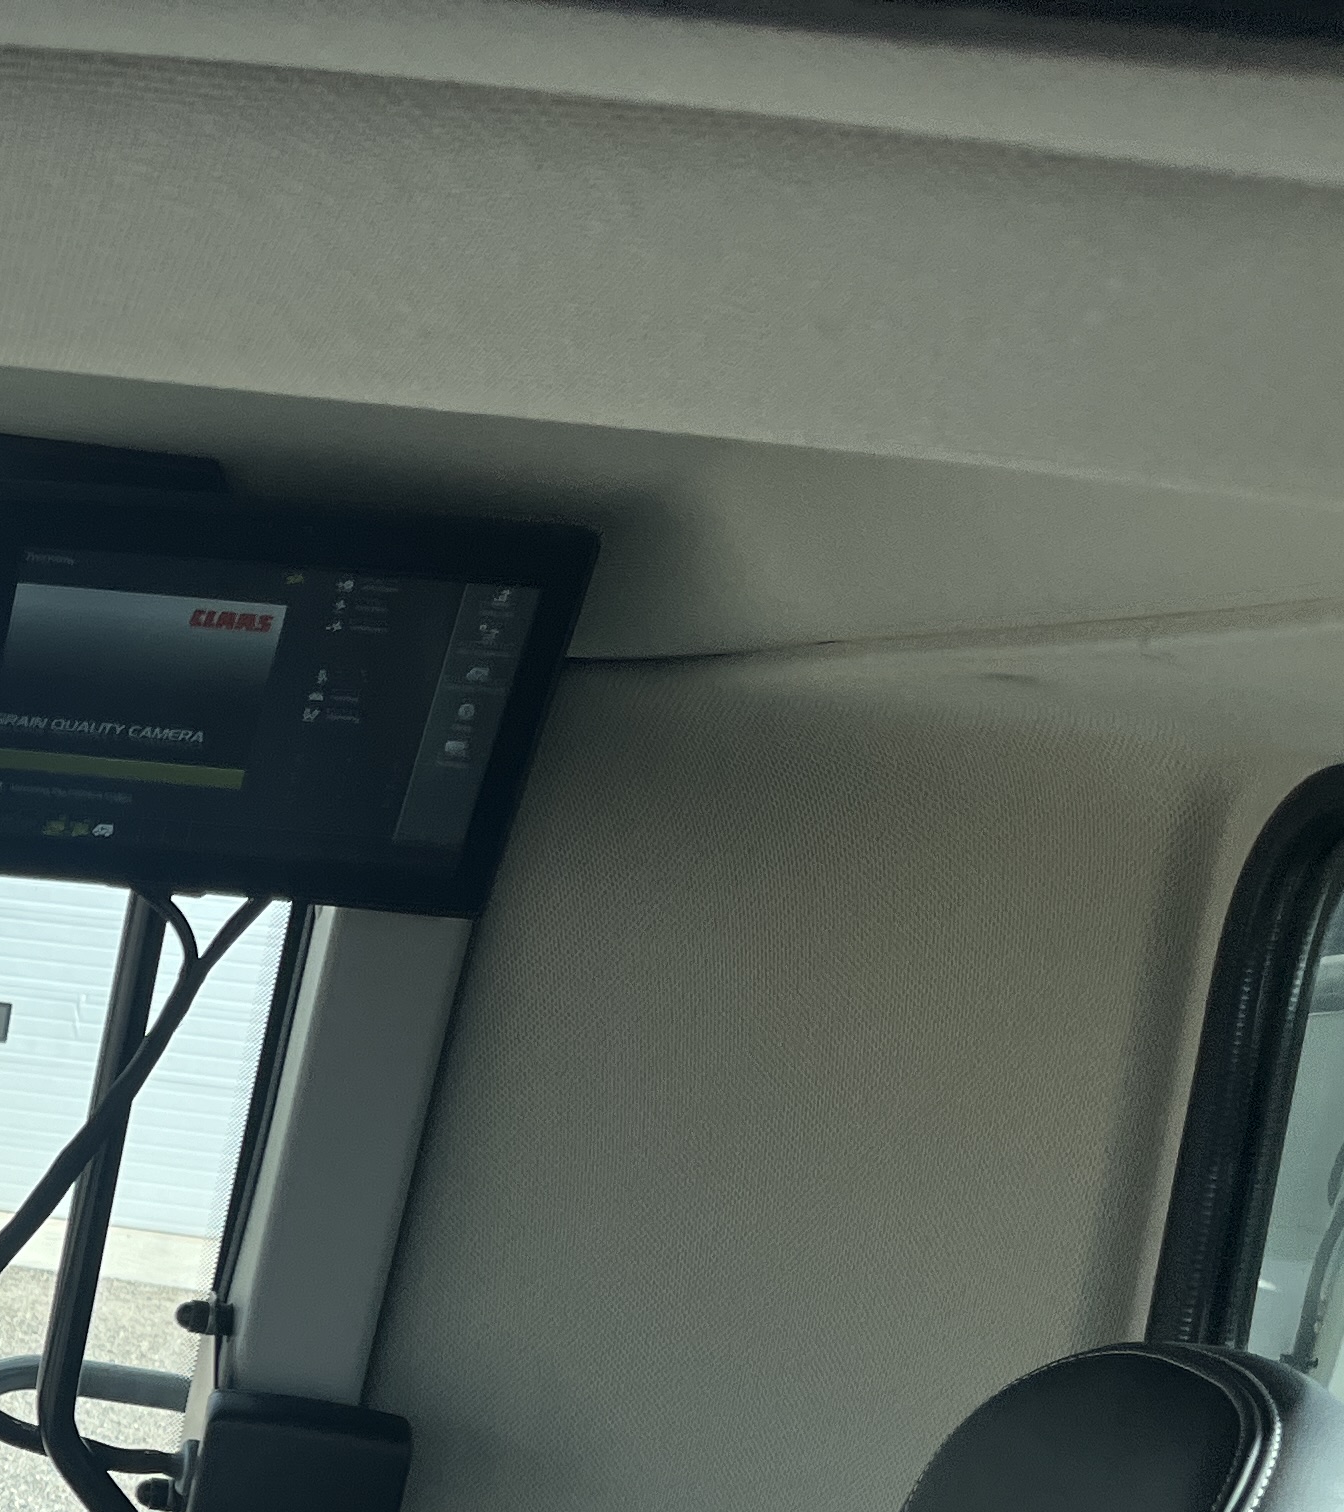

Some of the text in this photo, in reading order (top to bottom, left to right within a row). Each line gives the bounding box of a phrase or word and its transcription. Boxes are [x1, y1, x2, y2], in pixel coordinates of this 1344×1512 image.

[189, 608, 274, 633] CLAAS
[50, 718, 126, 736] QUALITY
[128, 725, 205, 744] CAMERA
